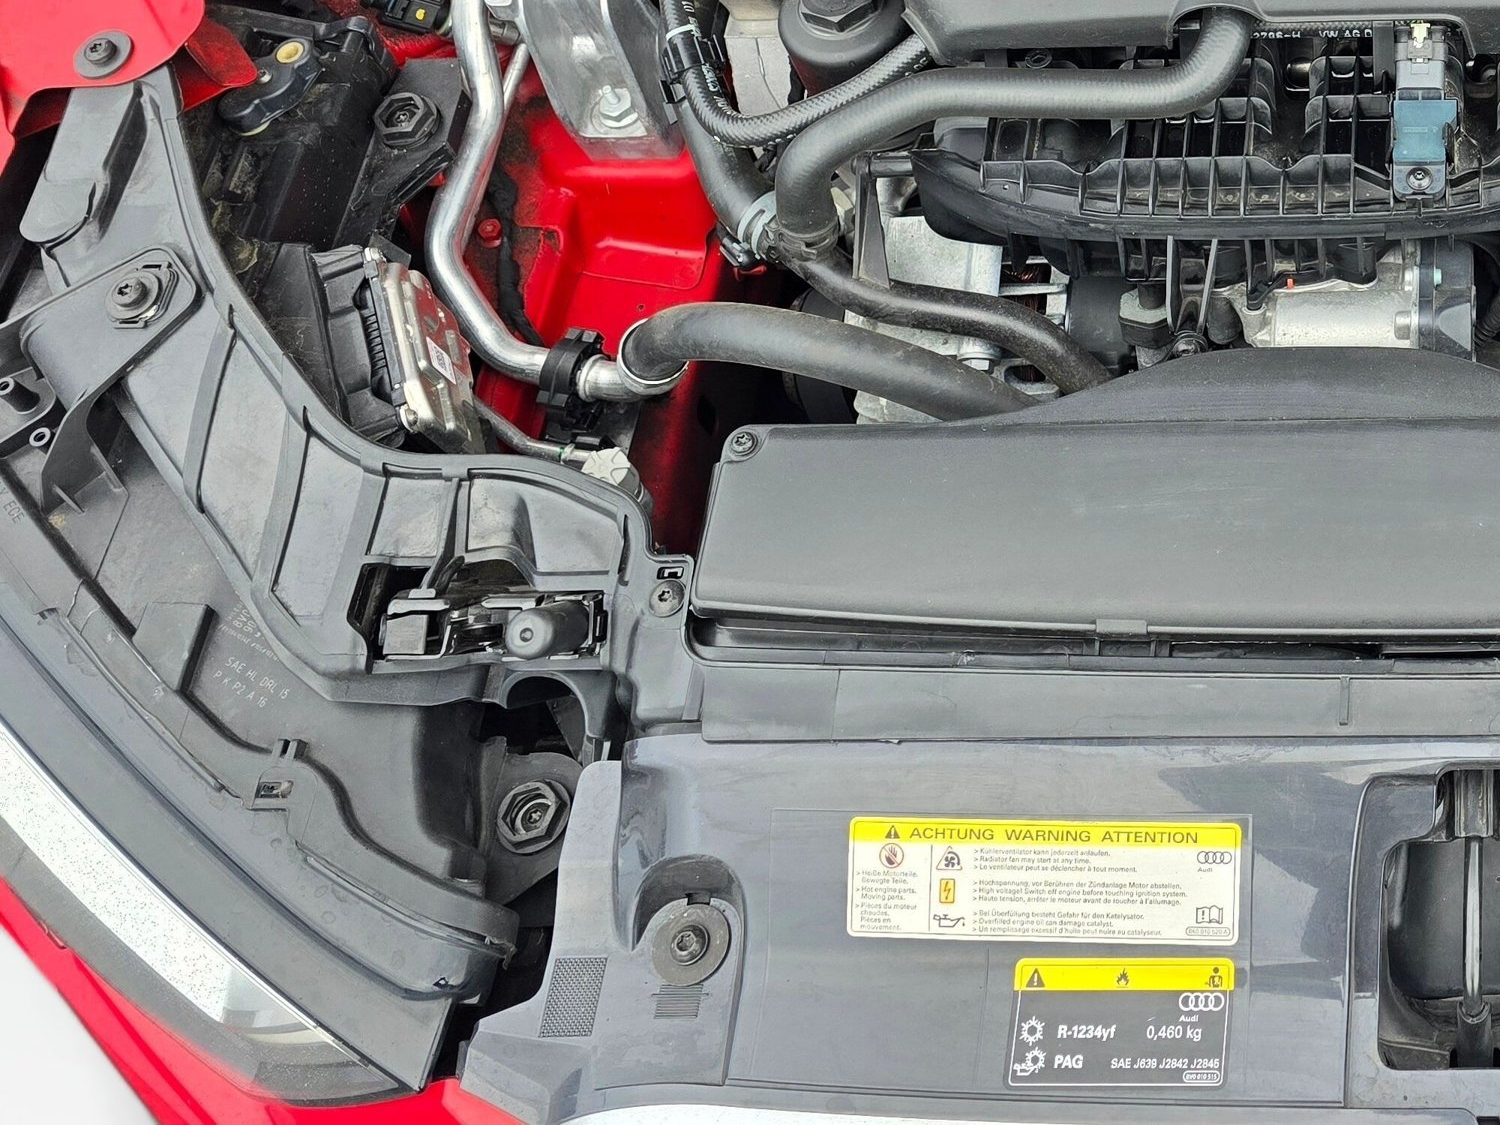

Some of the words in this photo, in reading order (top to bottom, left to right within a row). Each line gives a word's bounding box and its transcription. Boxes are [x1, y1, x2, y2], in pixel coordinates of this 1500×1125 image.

[1318, 30, 1339, 39] VW
[1343, 30, 1361, 39] AG
[3, 499, 25, 524] ECE
[224, 654, 246, 674] SAE
[244, 667, 259, 681] HL
[258, 675, 278, 693] DRL
[909, 827, 994, 840] ACHTUNG
[1005, 829, 1090, 841] WARNING
[1101, 830, 1198, 843] ATTENTION
[1061, 856, 1073, 864] any
[978, 879, 1028, 887] Hochspannung,
[1088, 881, 1126, 889] Zündanlage
[996, 887, 1022, 895] voltage!
[999, 894, 1025, 902] tension,
[1057, 895, 1081, 903] moteur
[1144, 898, 1181, 906] l'allumage.
[1012, 918, 1034, 926] engine
[990, 925, 1029, 933] remplissage
[1057, 1024, 1116, 1040] R-1234yf
[1146, 1025, 1182, 1040] 0,460
[1186, 1025, 1202, 1041] kg
[1054, 1055, 1083, 1067] PAG
[1111, 1058, 1131, 1068] SAE
[1133, 1058, 1157, 1068] J639
[1159, 1058, 1188, 1068] J2842
[1190, 1058, 1219, 1068] J2845
